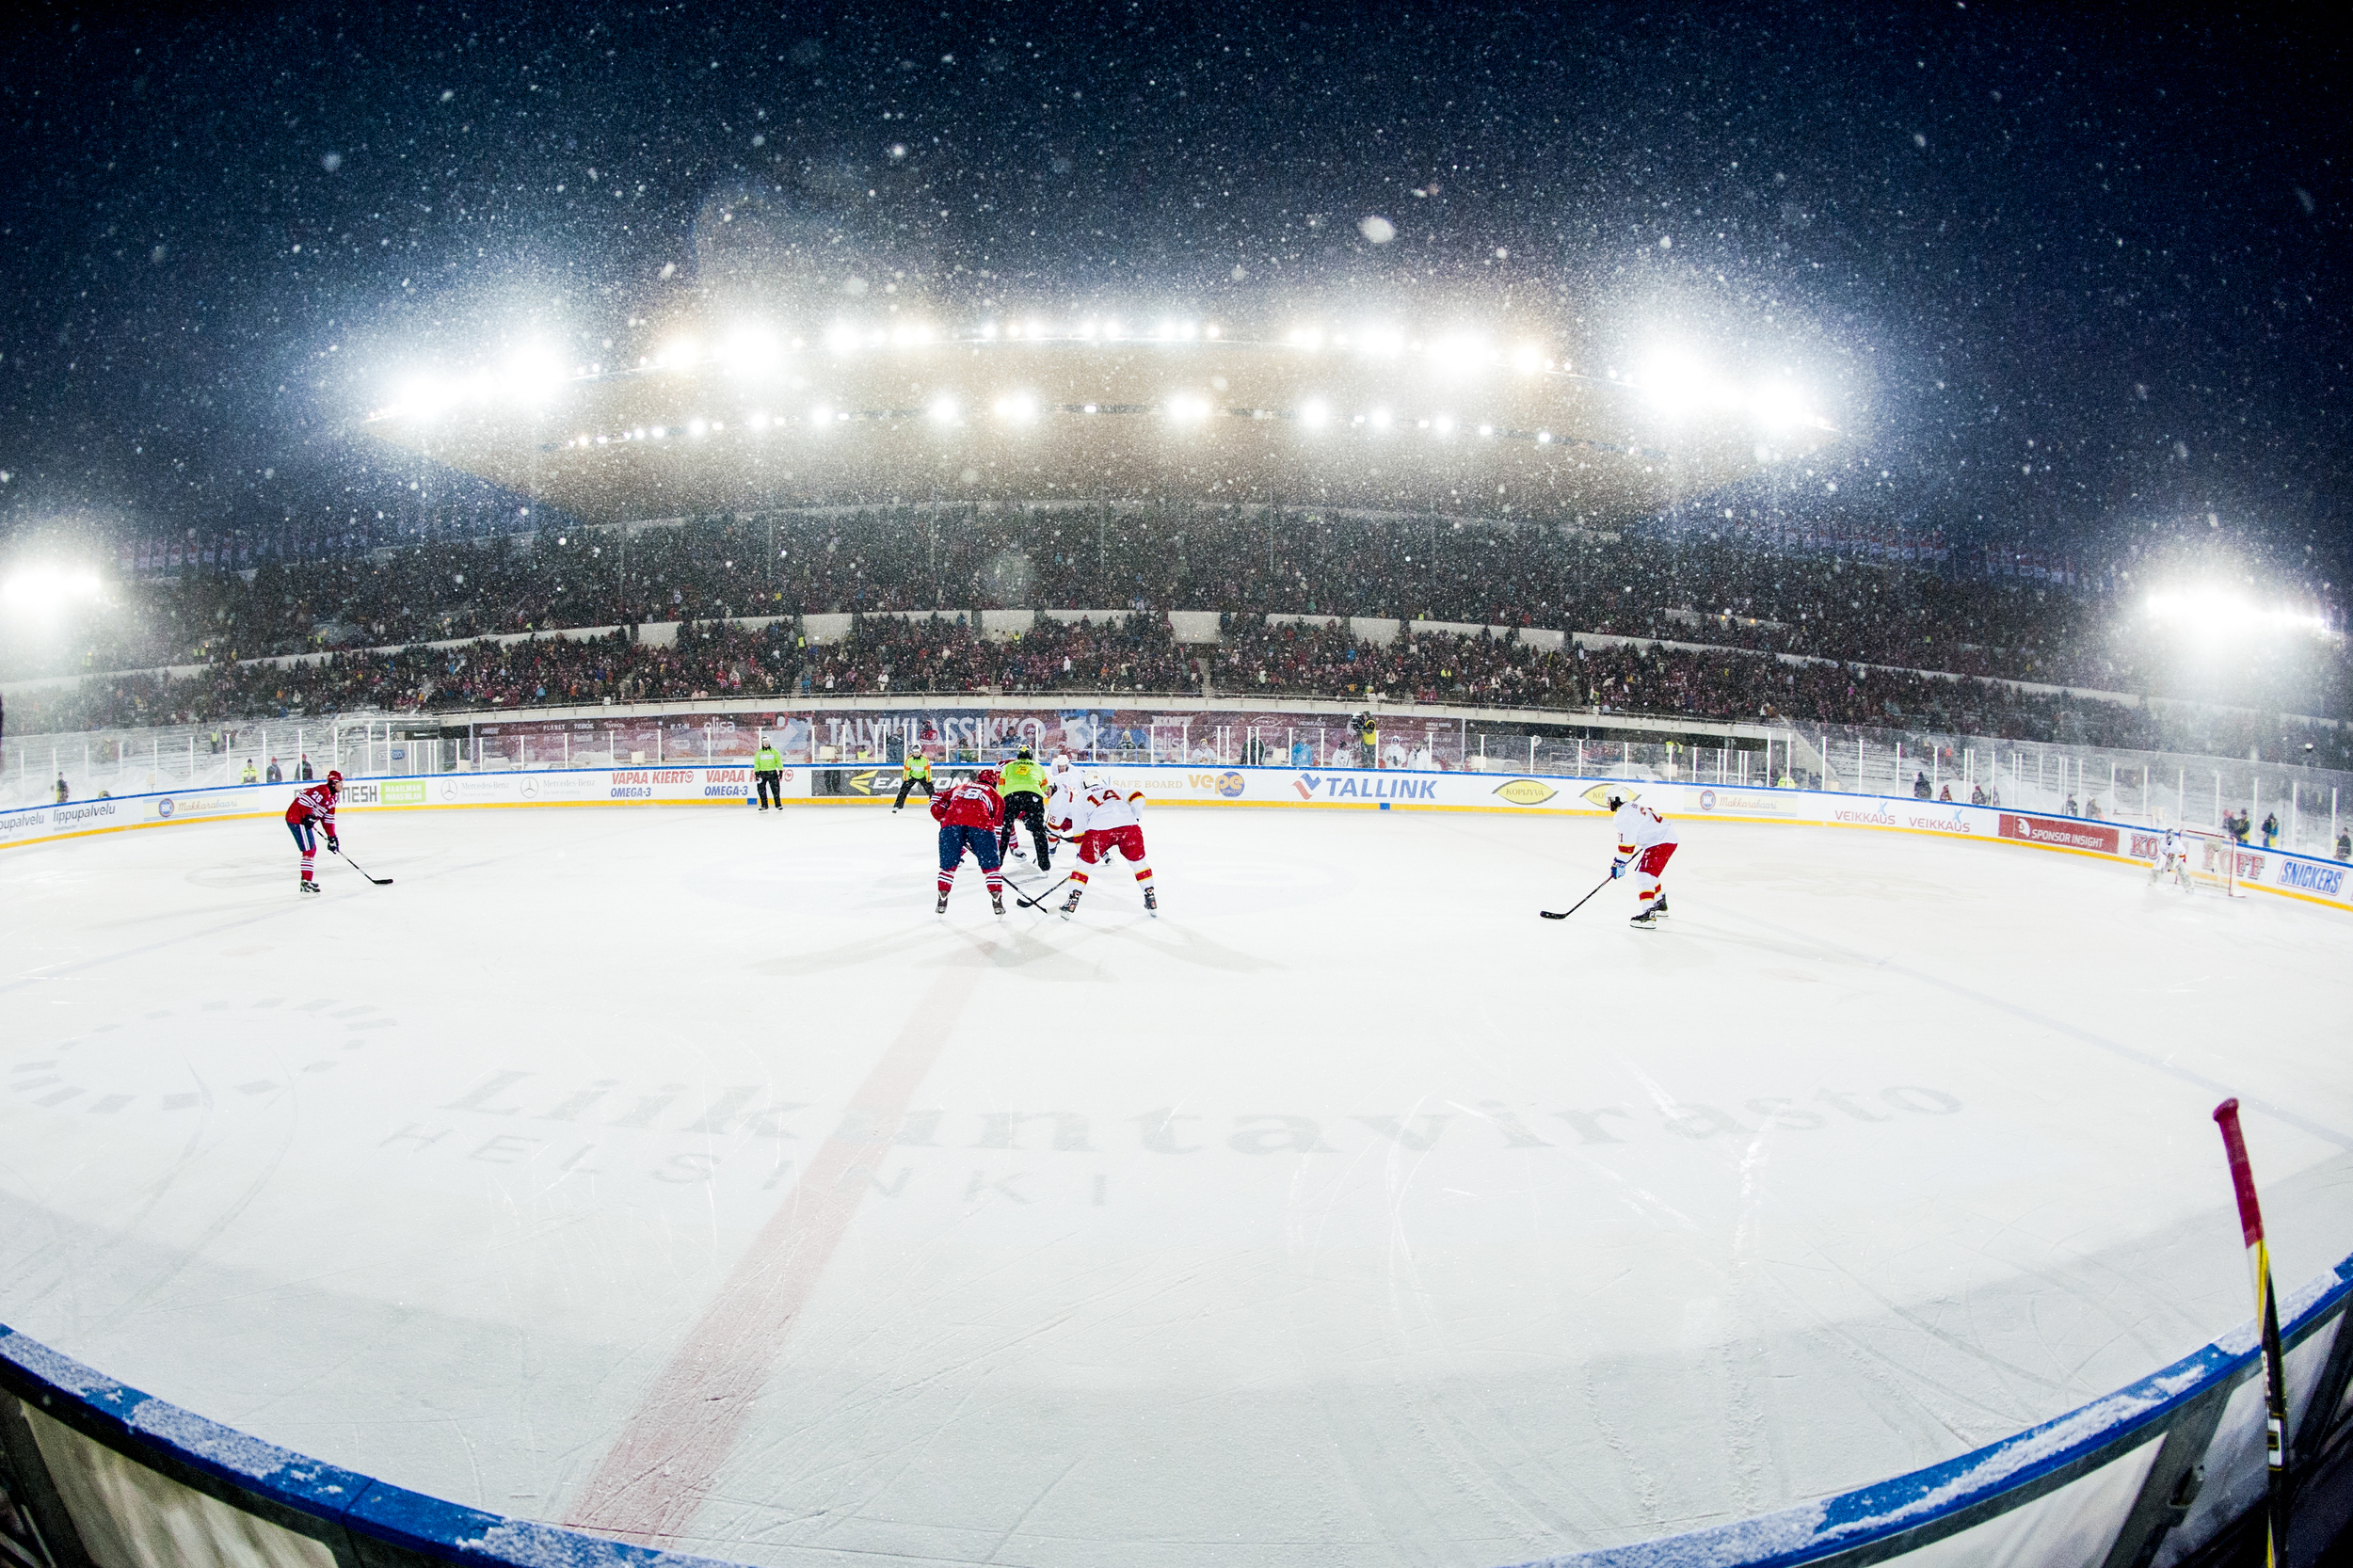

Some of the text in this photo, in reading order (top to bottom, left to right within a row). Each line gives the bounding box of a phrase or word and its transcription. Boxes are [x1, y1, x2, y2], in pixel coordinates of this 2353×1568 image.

[704, 717, 735, 734] elisa
[543, 778, 595, 788] Mercedes-Benz
[612, 772, 648, 784] VAPAA
[706, 770, 744, 783] VAPAA
[872, 777, 969, 789] EAON
[385, 784, 422, 792] MAAILMAN
[461, 781, 509, 790] Mercedes-Benz
[705, 786, 748, 796] OMEGA-3
[1112, 780, 1183, 789] SAFE BOARD
[1188, 775, 1244, 794] vepe
[1326, 777, 1438, 799] TALLINK
[611, 787, 651, 797] OMEGA-3
[964, 787, 983, 799] 8
[178, 798, 238, 812] Makkarabaari
[1086, 790, 1121, 808] 14
[1703, 795, 1713, 805] HK
[1720, 796, 1777, 809] Makkarabaari
[53, 802, 116, 824] lippupalvelu
[161, 803, 171, 812] HK
[1835, 810, 1896, 824] VEIKKAUS
[1909, 817, 1970, 832] VEIKKAUS
[2032, 829, 2104, 848] SPONSOR INSIGHT
[2281, 861, 2342, 894] SNICKERS
[436, 1069, 1965, 1156] Liikuntavirasto
[379, 1121, 1108, 1207] HELSINKI
